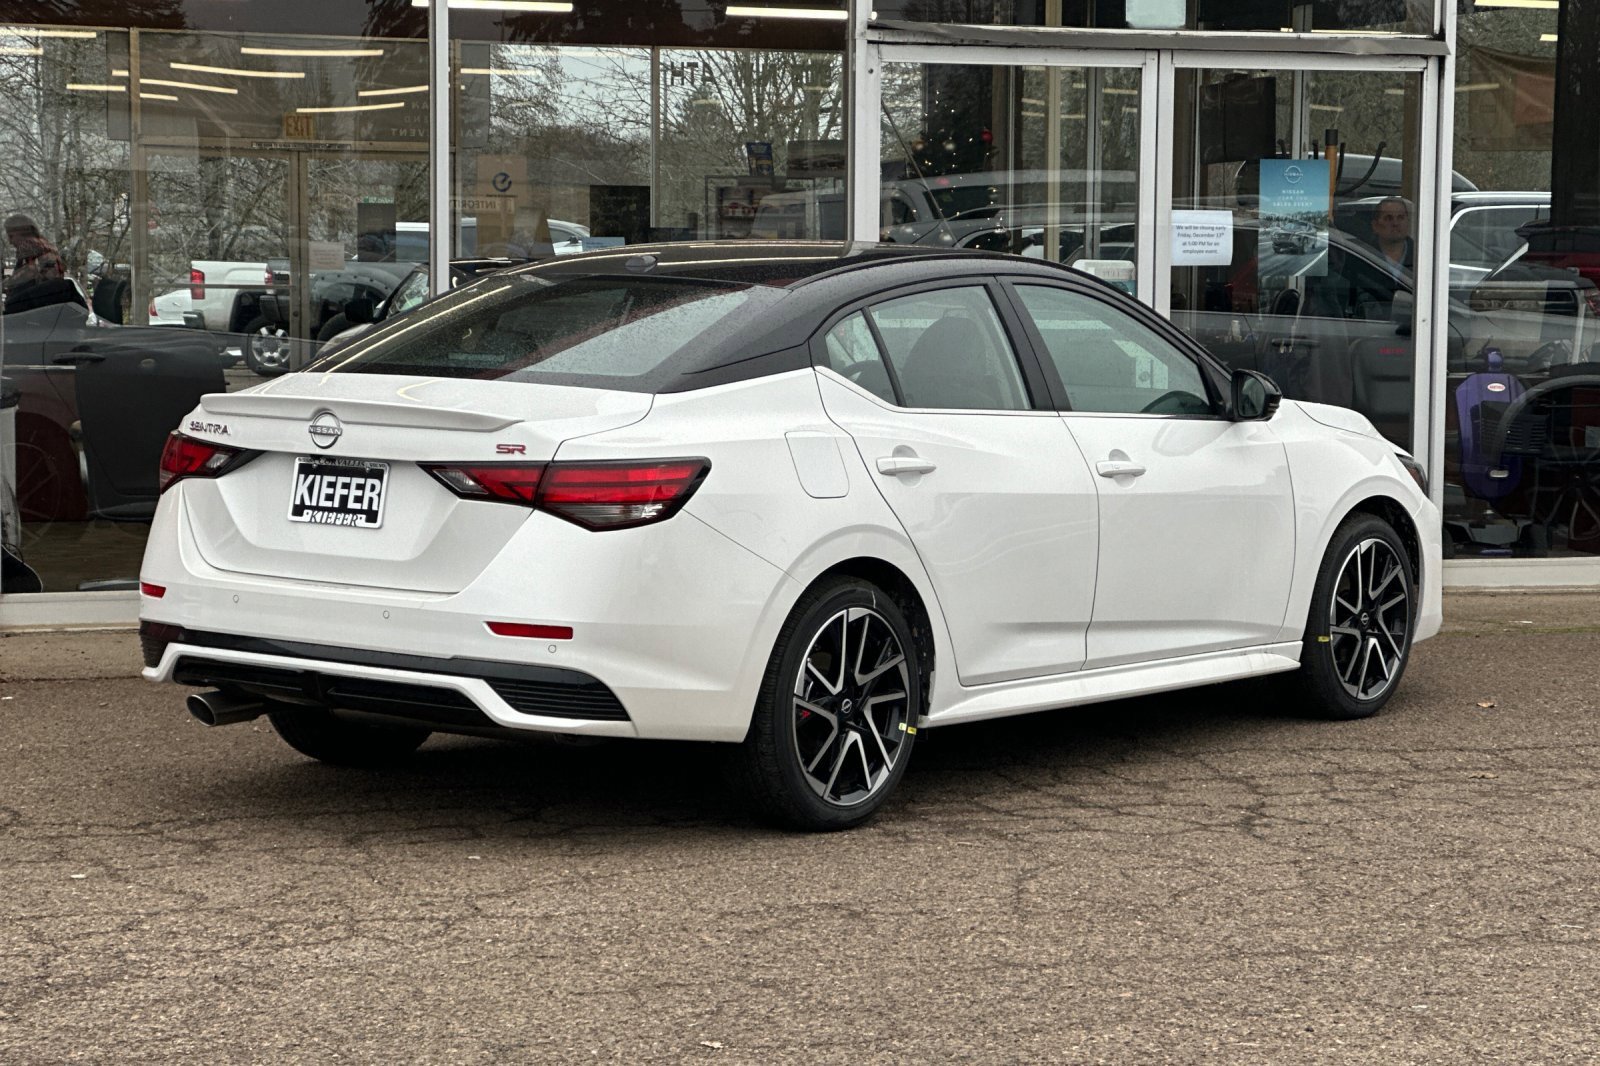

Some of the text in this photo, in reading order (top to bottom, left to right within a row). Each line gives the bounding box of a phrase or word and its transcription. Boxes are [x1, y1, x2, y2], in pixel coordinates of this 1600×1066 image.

[285, 115, 313, 138] EXIT
[190, 420, 232, 436] SENTRA
[308, 426, 342, 436] NISSAN
[495, 443, 527, 455] SR
[294, 473, 382, 511] KIEFER
[310, 510, 359, 527] KIEFER
